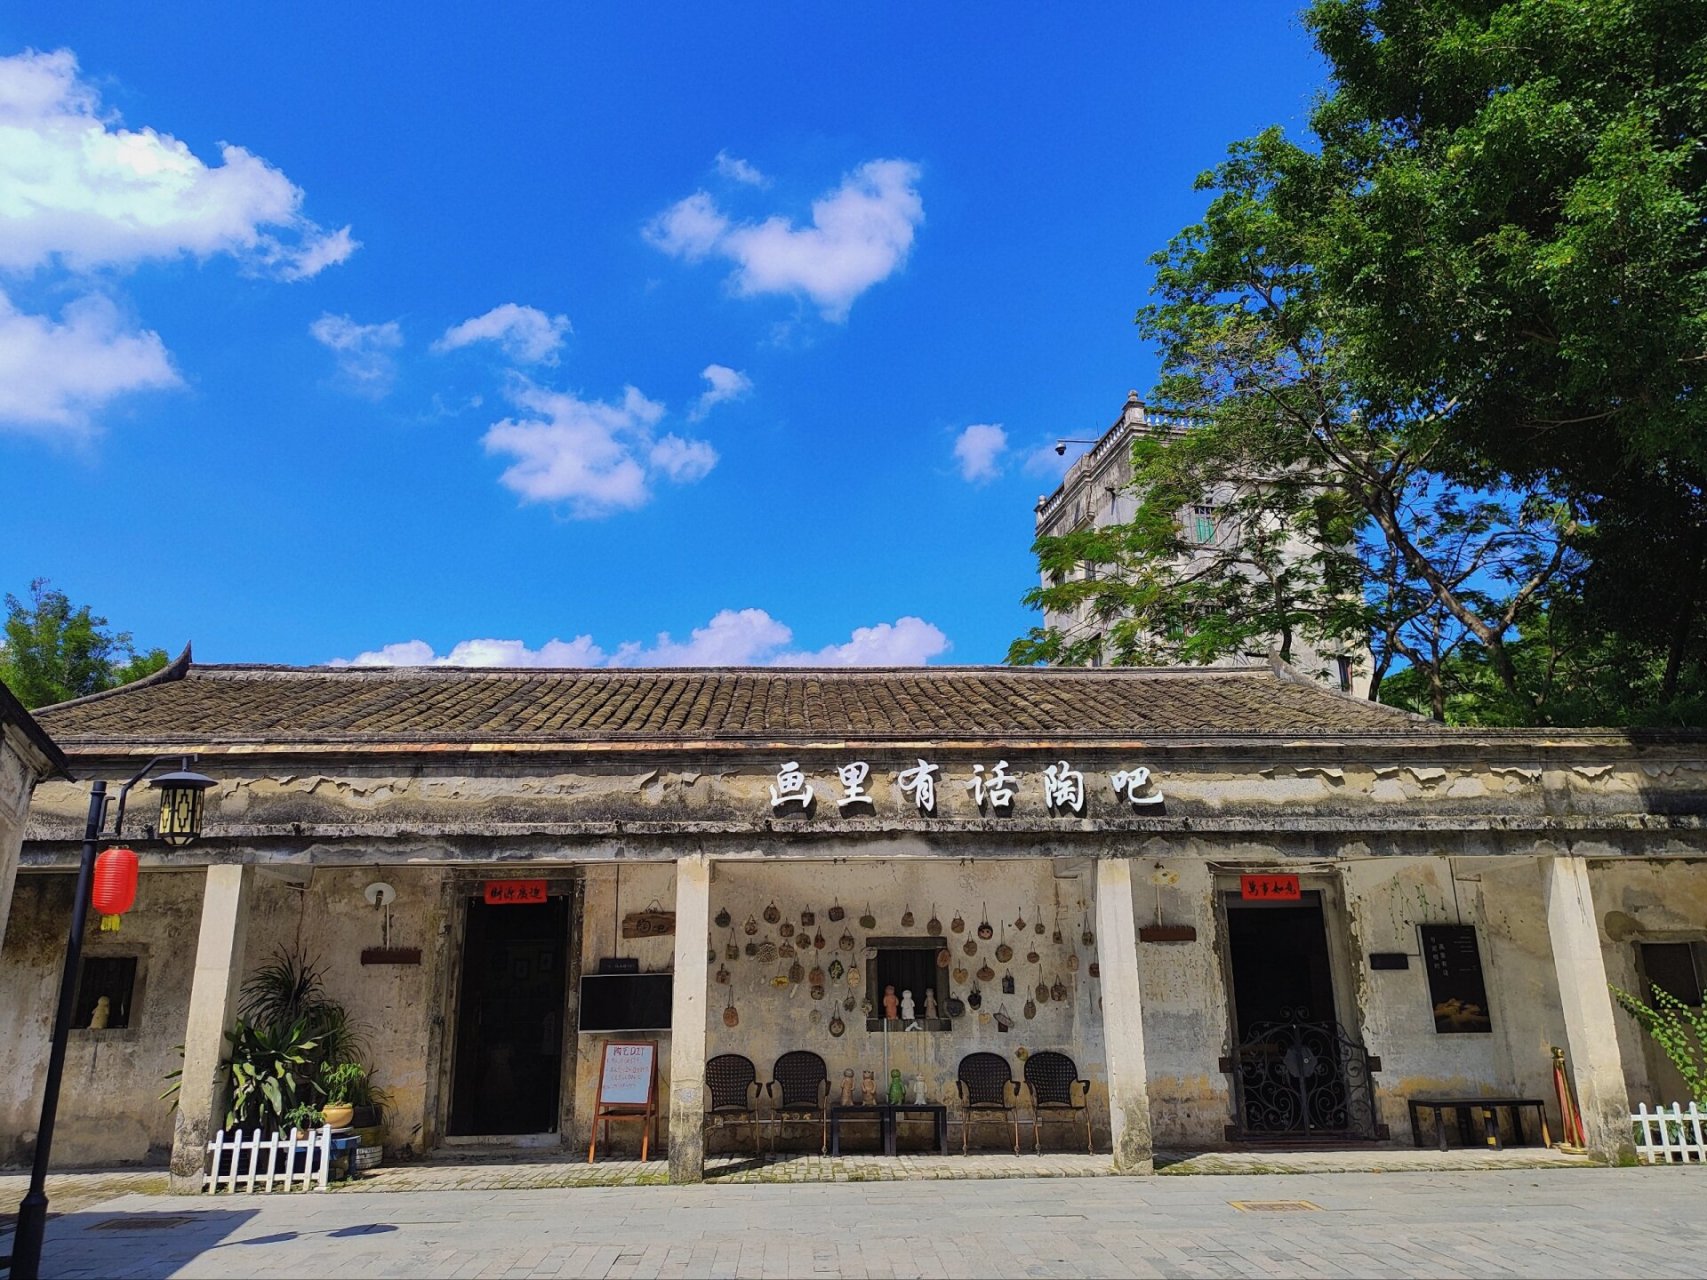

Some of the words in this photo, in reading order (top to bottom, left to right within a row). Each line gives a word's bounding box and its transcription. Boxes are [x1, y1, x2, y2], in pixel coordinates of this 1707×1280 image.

[769, 758, 1164, 813] 画里有话陶吧
